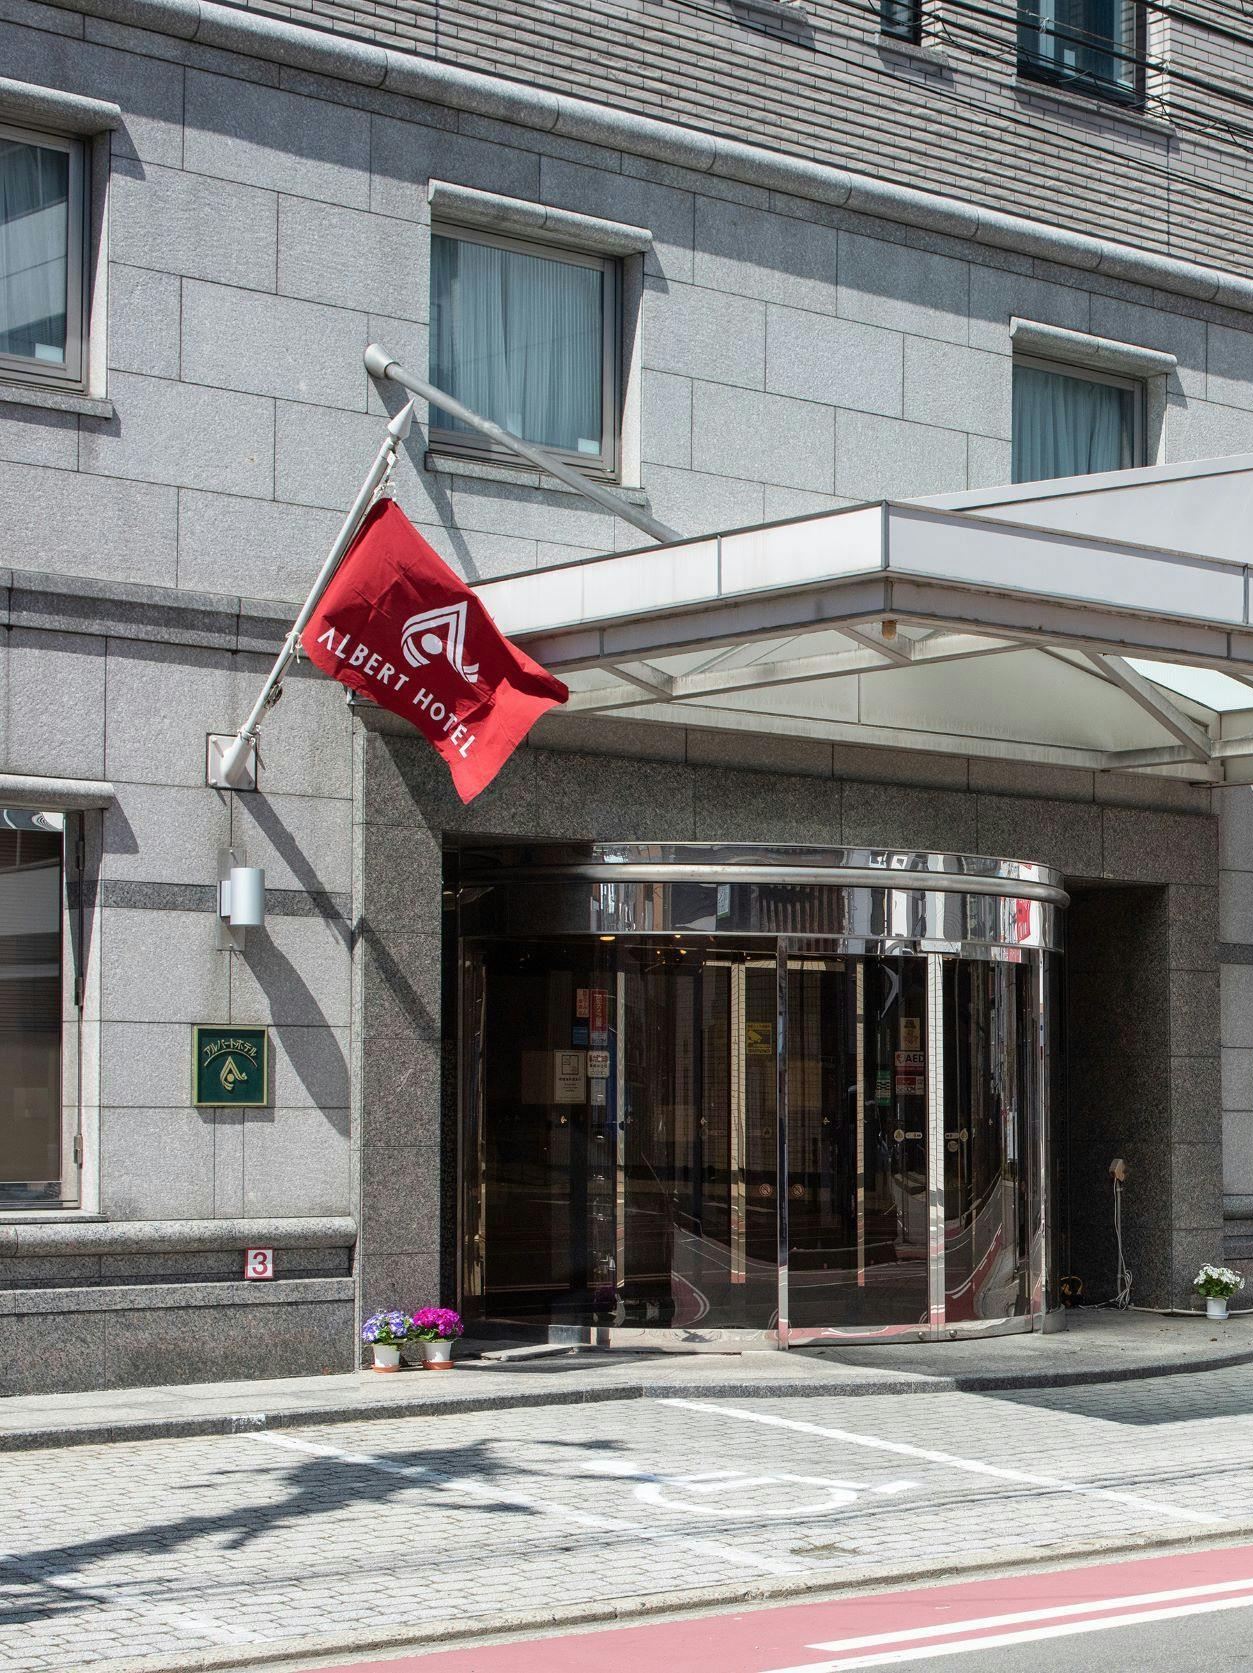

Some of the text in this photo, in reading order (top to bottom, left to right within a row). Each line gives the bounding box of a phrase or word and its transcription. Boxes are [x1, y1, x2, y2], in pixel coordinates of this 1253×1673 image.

[316, 625, 477, 759] ALBERT HOTEL
[203, 1038, 258, 1057] アルバートホテル
[905, 1053, 925, 1064] AED
[252, 1252, 268, 1275] 3
